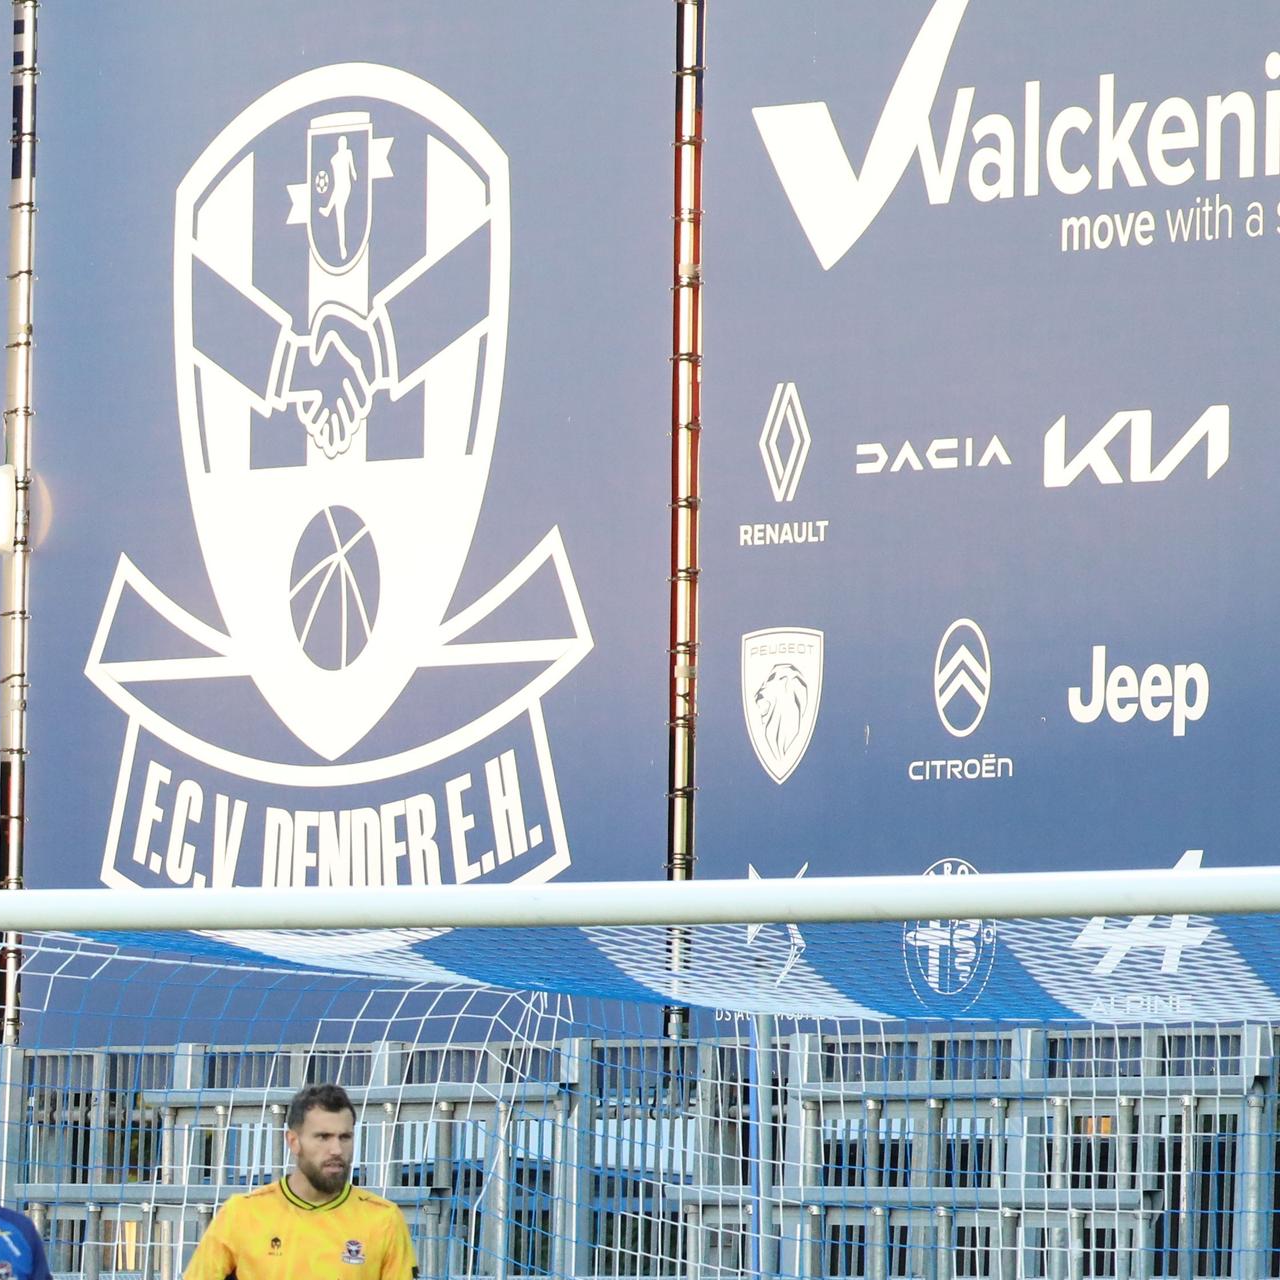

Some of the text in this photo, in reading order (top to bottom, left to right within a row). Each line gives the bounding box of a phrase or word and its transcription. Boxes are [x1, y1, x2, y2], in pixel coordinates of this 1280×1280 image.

[1061, 209, 1155, 252] move
[1166, 193, 1233, 244] with
[1245, 202, 1265, 238] a
[855, 434, 1012, 475] DACIA
[739, 520, 829, 546] RENAULT
[750, 643, 815, 657] PEUGEOT
[1068, 645, 1209, 737] Jeep
